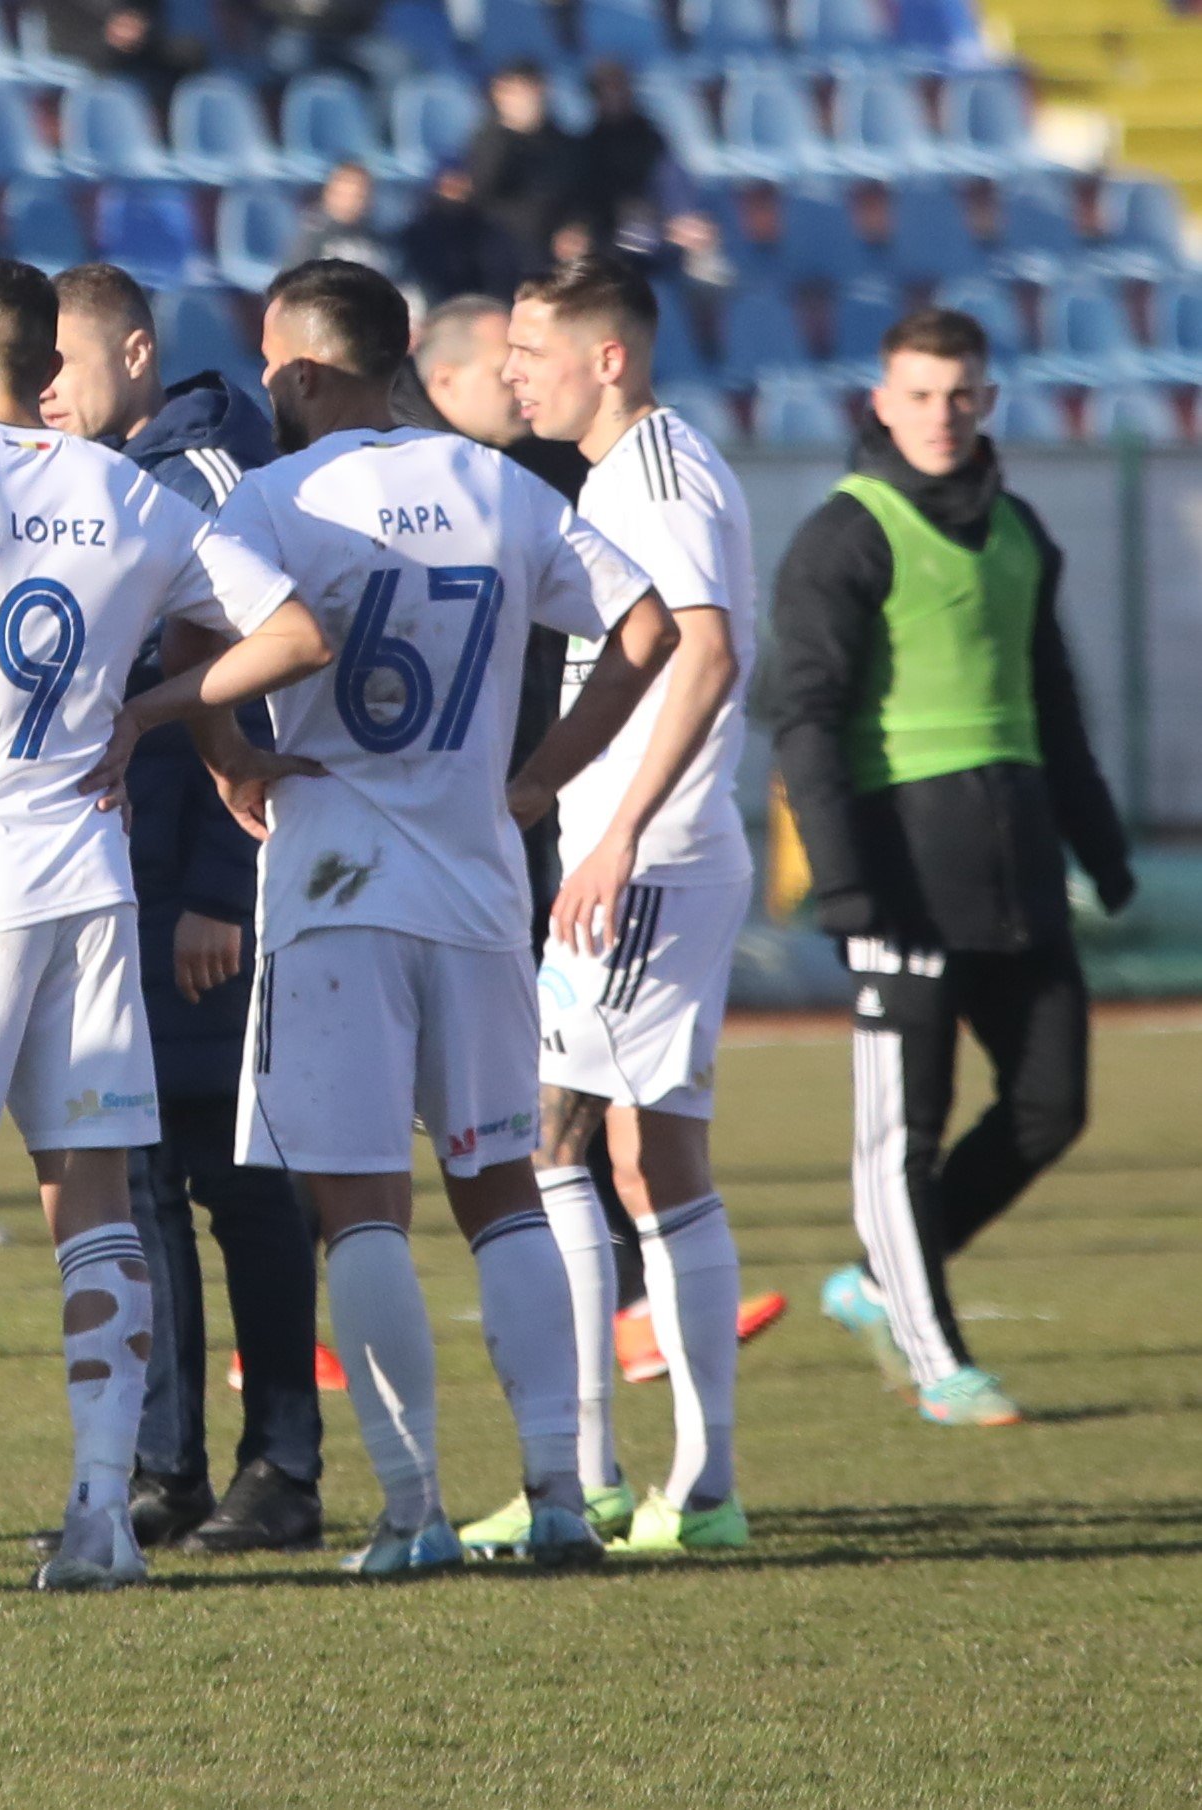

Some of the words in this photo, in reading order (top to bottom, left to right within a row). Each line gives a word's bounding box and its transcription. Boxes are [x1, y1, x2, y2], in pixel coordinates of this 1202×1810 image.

[11, 511, 106, 547] LOPEZ
[378, 504, 453, 535] PAPA
[335, 565, 504, 754] 67
